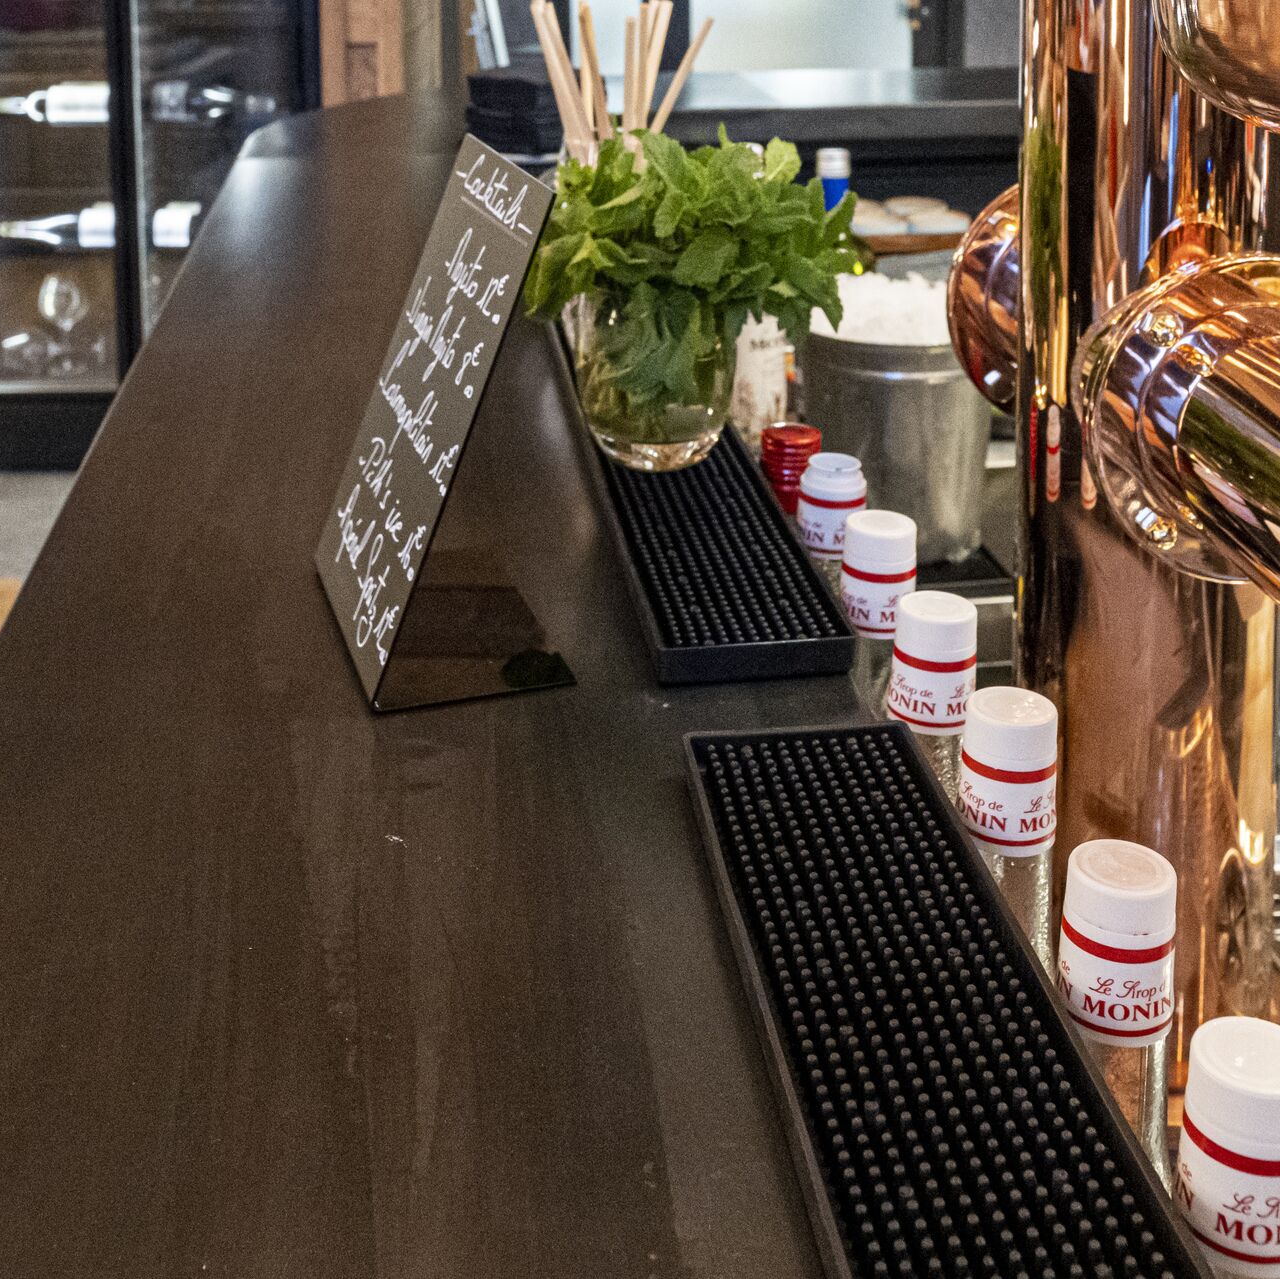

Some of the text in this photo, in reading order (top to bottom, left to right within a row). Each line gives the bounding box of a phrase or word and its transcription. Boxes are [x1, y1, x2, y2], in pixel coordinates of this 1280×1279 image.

[888, 686, 936, 716] ONIN
[988, 801, 1004, 812] de
[1023, 795, 1043, 814] Le
[1088, 976, 1114, 996] Le
[1116, 980, 1157, 1001] Sirop
[1082, 994, 1172, 1021] MONIN
[1222, 1192, 1255, 1215] Le
